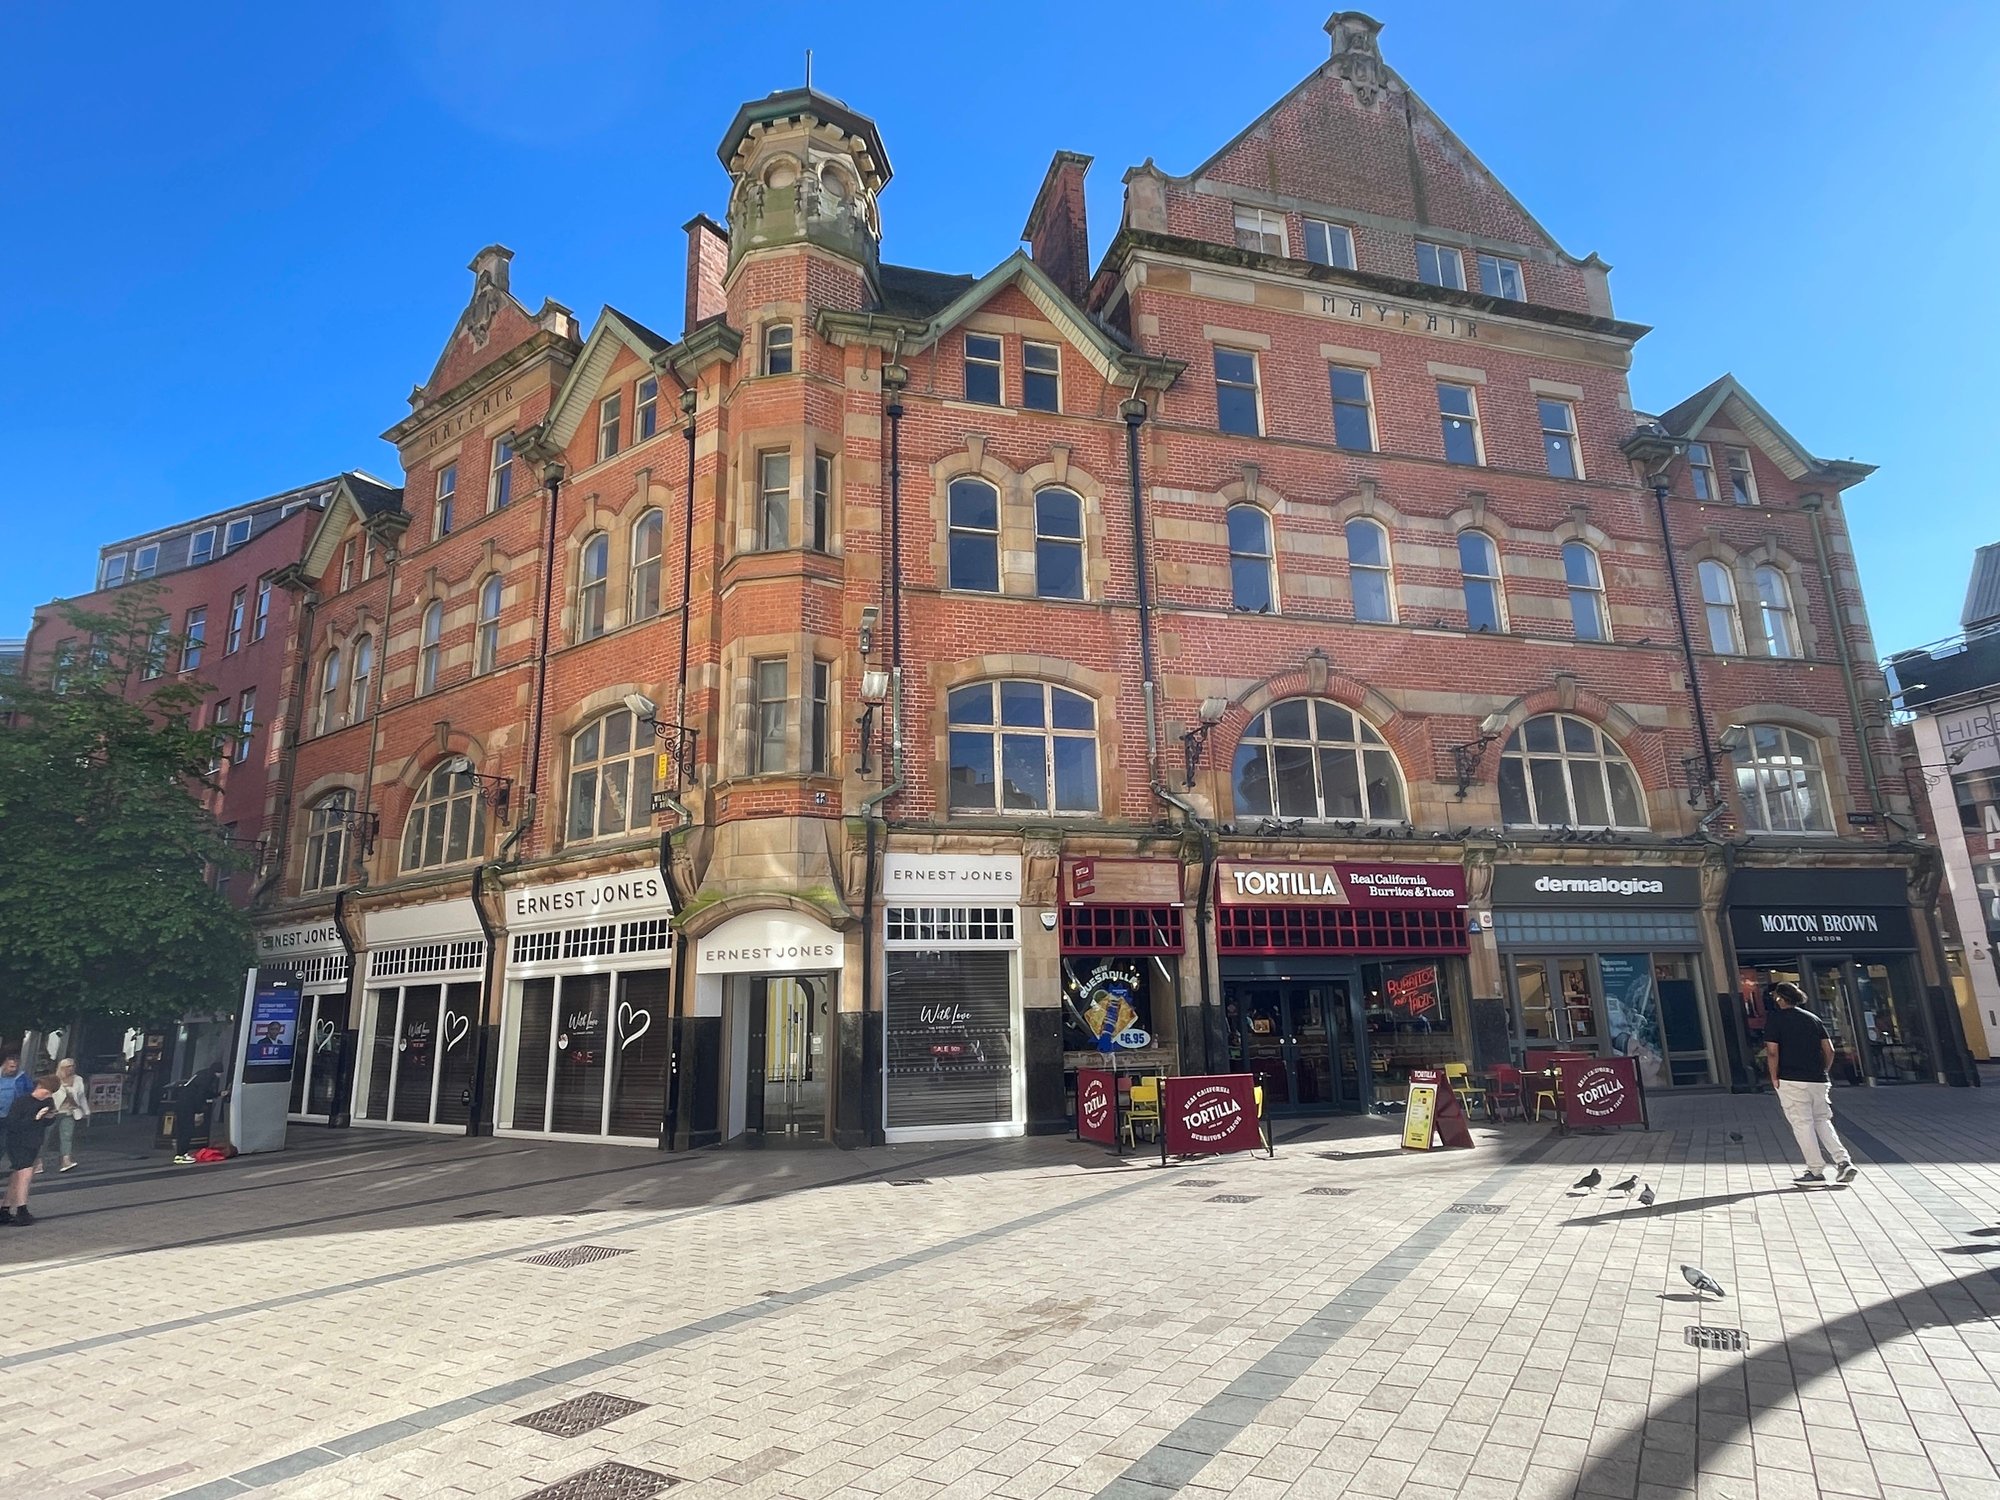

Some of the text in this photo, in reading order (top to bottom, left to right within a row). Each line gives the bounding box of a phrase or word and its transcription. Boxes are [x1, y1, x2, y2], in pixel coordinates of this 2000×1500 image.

[1322, 296, 1478, 338] MAYFAIR
[429, 385, 513, 447] MAYFAIR
[894, 870, 1013, 881] ERNEST JONES
[1233, 871, 1337, 895] TORTILLA
[1350, 873, 1427, 885] Real California
[1369, 886, 1454, 897] Burritos & Tacos
[1535, 876, 1663, 895] dermalogica
[517, 879, 657, 915] ERNEST JONES
[1760, 915, 1878, 932] MOLTON BROWN
[304, 927, 341, 944] JONES
[706, 945, 834, 961] ERNEST JONES
[1091, 965, 1108, 975] NEW
[921, 1003, 972, 1025] With Love
[1120, 1033, 1145, 1044] £6.95
[1414, 1070, 1437, 1078] TORTILLA
[1576, 1079, 1624, 1106] TORTILLA
[1182, 1098, 1241, 1130] TORTILLA
